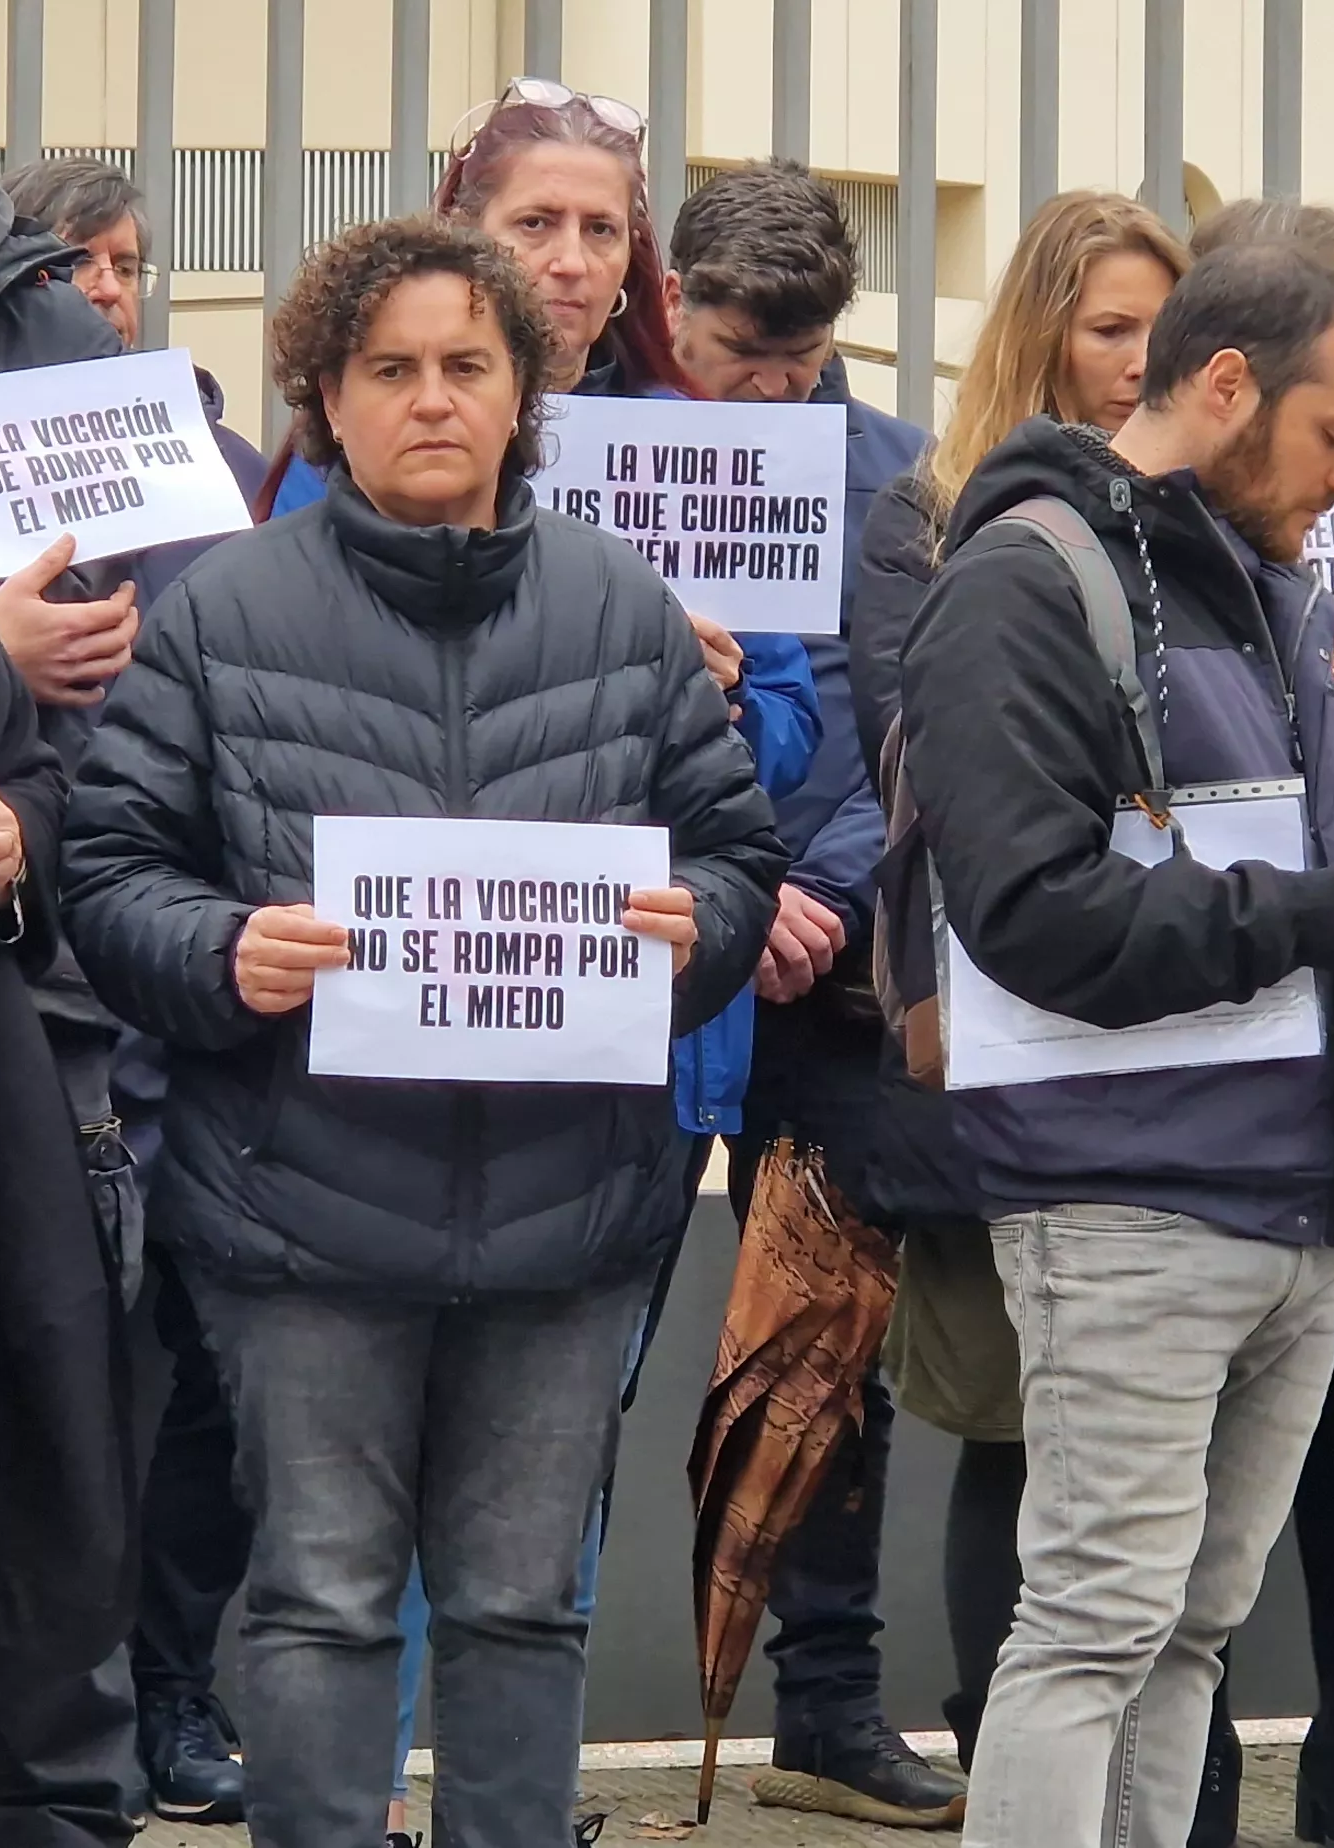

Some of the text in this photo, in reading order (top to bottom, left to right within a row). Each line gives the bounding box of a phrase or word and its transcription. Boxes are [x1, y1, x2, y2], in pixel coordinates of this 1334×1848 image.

[30, 396, 174, 448] VOCACIÓN
[24, 445, 130, 487] ROMPA
[132, 438, 195, 468] POR
[606, 443, 767, 487] LA VIDA DE
[9, 475, 145, 535] EL MIEDO
[614, 490, 668, 531] QUE
[681, 494, 828, 534] CUIDAMOS
[693, 541, 820, 581] IMPORTA
[353, 874, 413, 921] QUE
[427, 876, 462, 921] LA
[347, 927, 639, 979] NO SE ROMPA POR
[420, 983, 565, 1030] EL MIEDO
